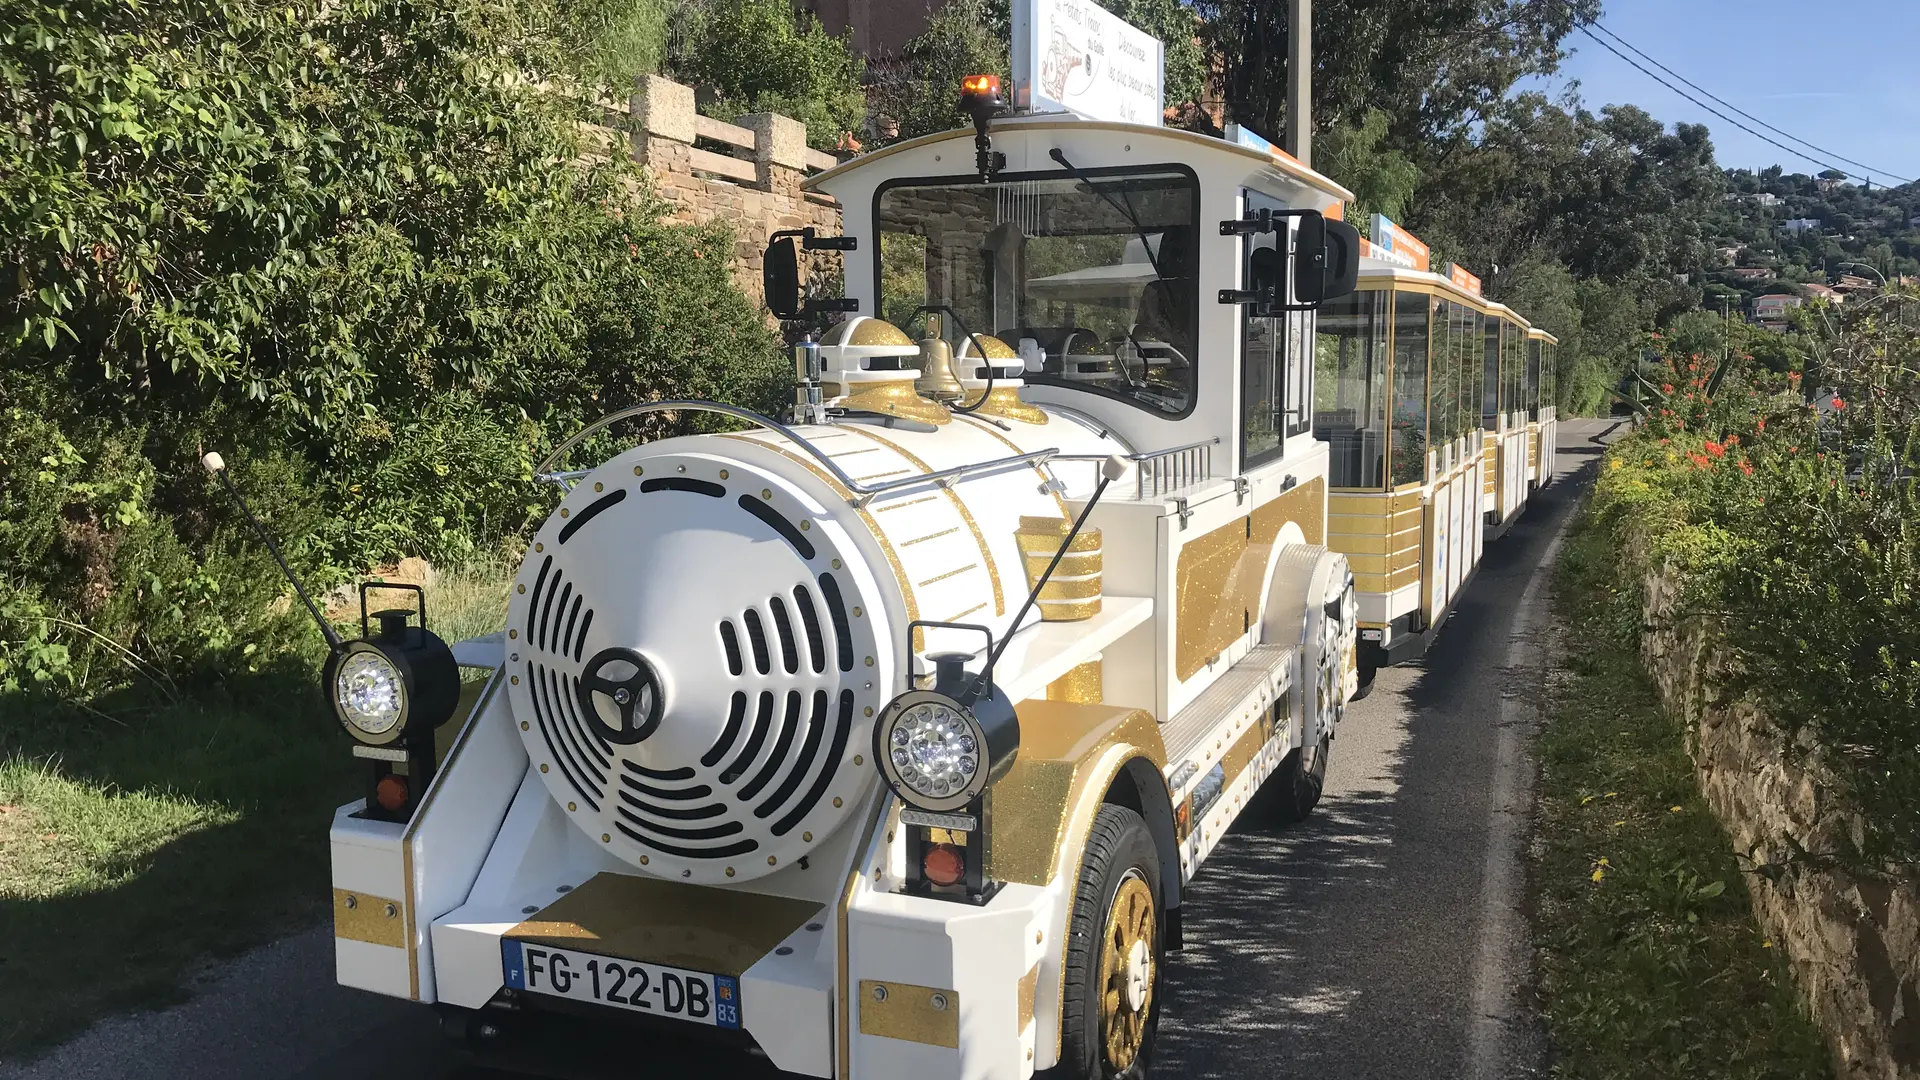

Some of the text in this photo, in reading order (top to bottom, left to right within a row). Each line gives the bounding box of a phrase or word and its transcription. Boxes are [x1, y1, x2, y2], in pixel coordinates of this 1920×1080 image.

[1118, 31, 1146, 62] Découvrez
[1117, 62, 1126, 90] plus
[510, 969, 518, 981] F
[526, 948, 710, 1018] FG-122-DB
[717, 1003, 736, 1024] 83
